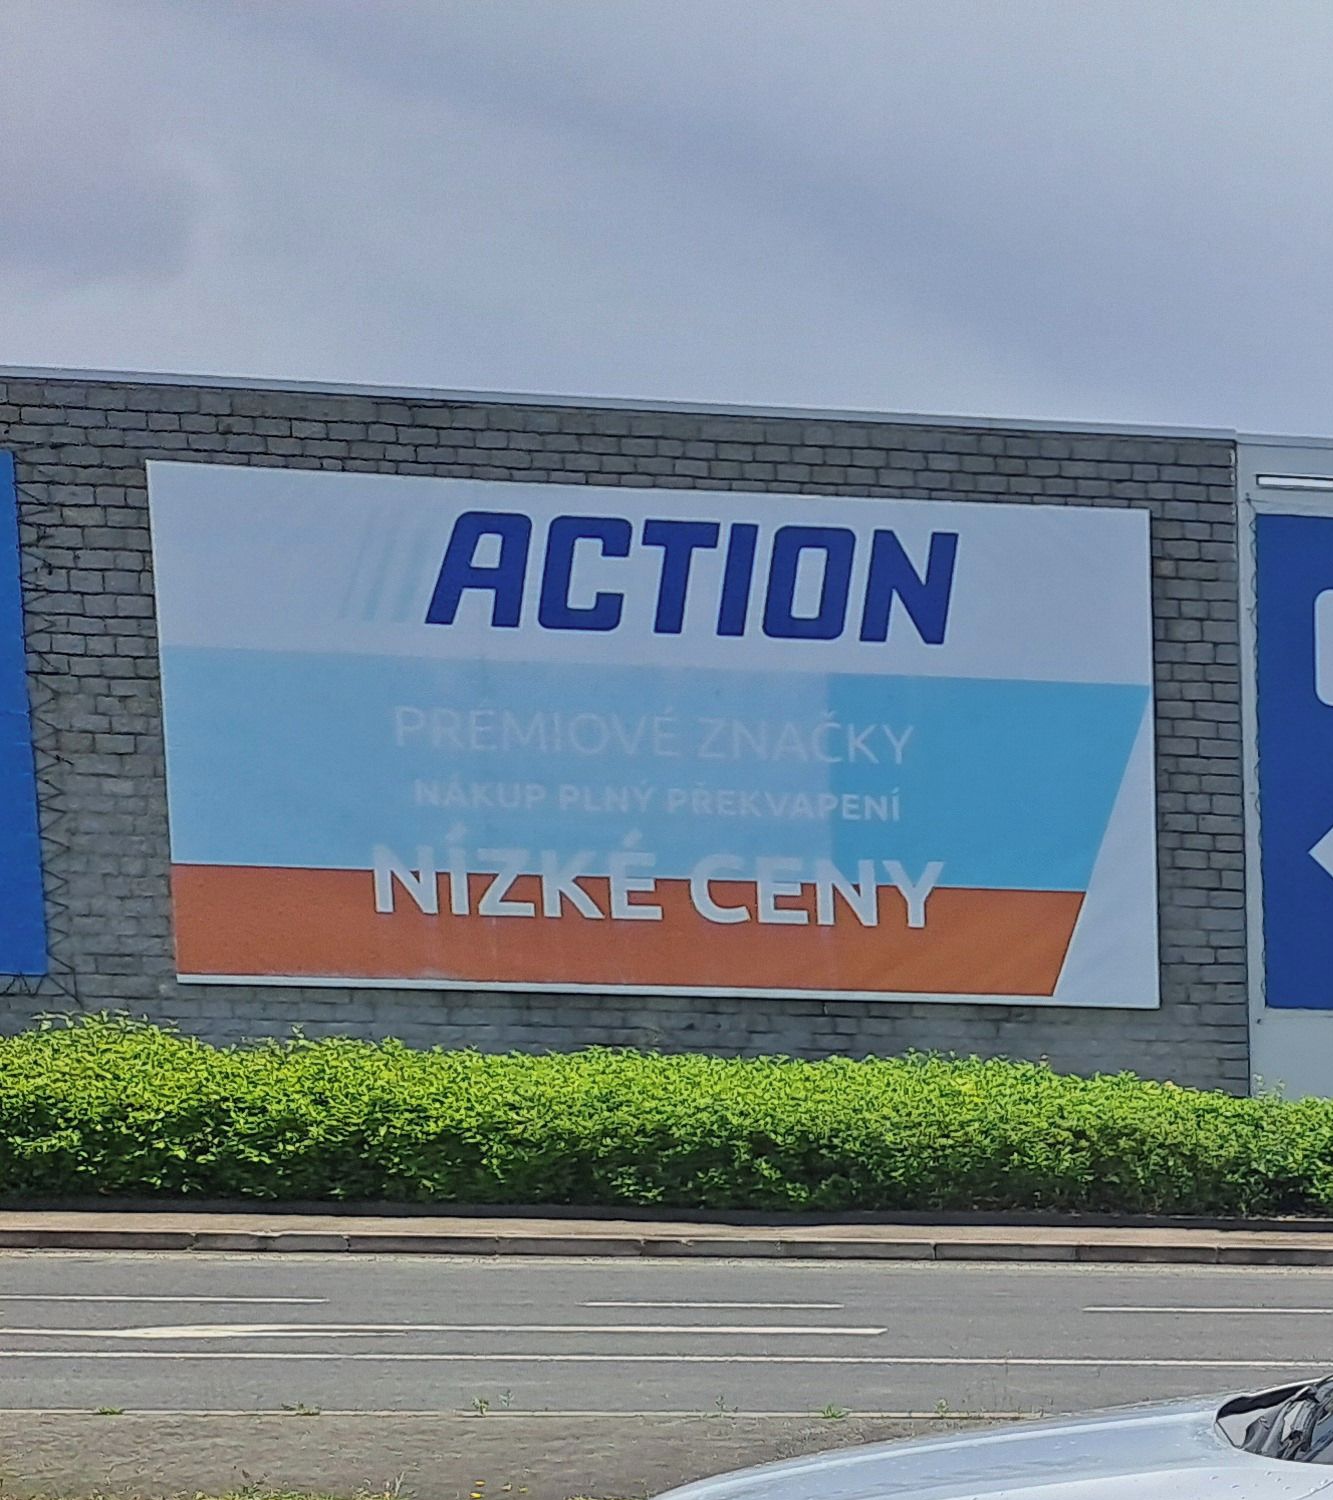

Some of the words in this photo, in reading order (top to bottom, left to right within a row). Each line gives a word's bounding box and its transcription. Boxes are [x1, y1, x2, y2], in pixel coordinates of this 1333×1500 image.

[425, 511, 959, 645] ACTION
[698, 711, 914, 765] ZNAČKY
[414, 773, 547, 811] NÁKUP
[559, 780, 655, 814] PLNÝ
[666, 784, 900, 822] PŘEKVAPENÍ
[372, 822, 664, 921] NÍZKÉ
[690, 851, 945, 929] CENY
